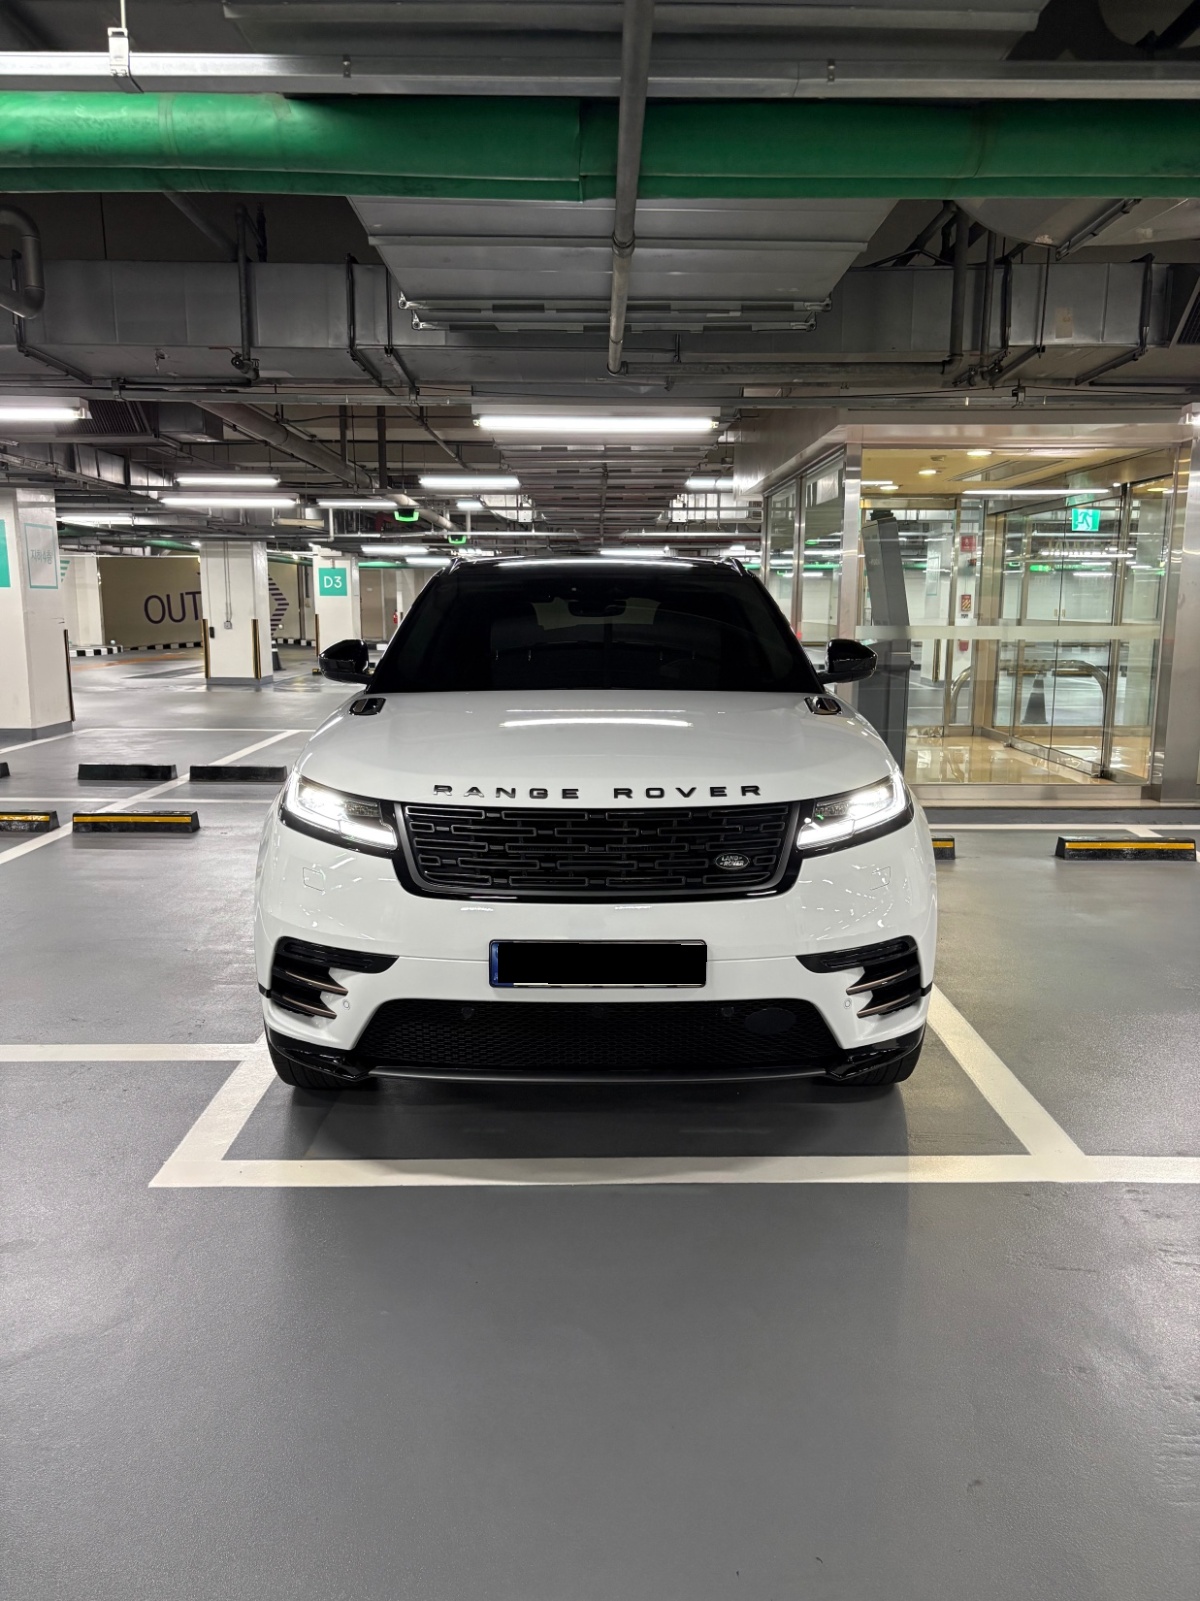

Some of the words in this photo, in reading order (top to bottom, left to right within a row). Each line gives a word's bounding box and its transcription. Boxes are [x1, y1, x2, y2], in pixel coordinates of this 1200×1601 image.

[30, 549, 53, 565] 지하4층
[323, 575, 342, 589] D3
[143, 591, 201, 625] OUT
[433, 784, 579, 800] RANGE
[613, 784, 761, 800] ROVER
